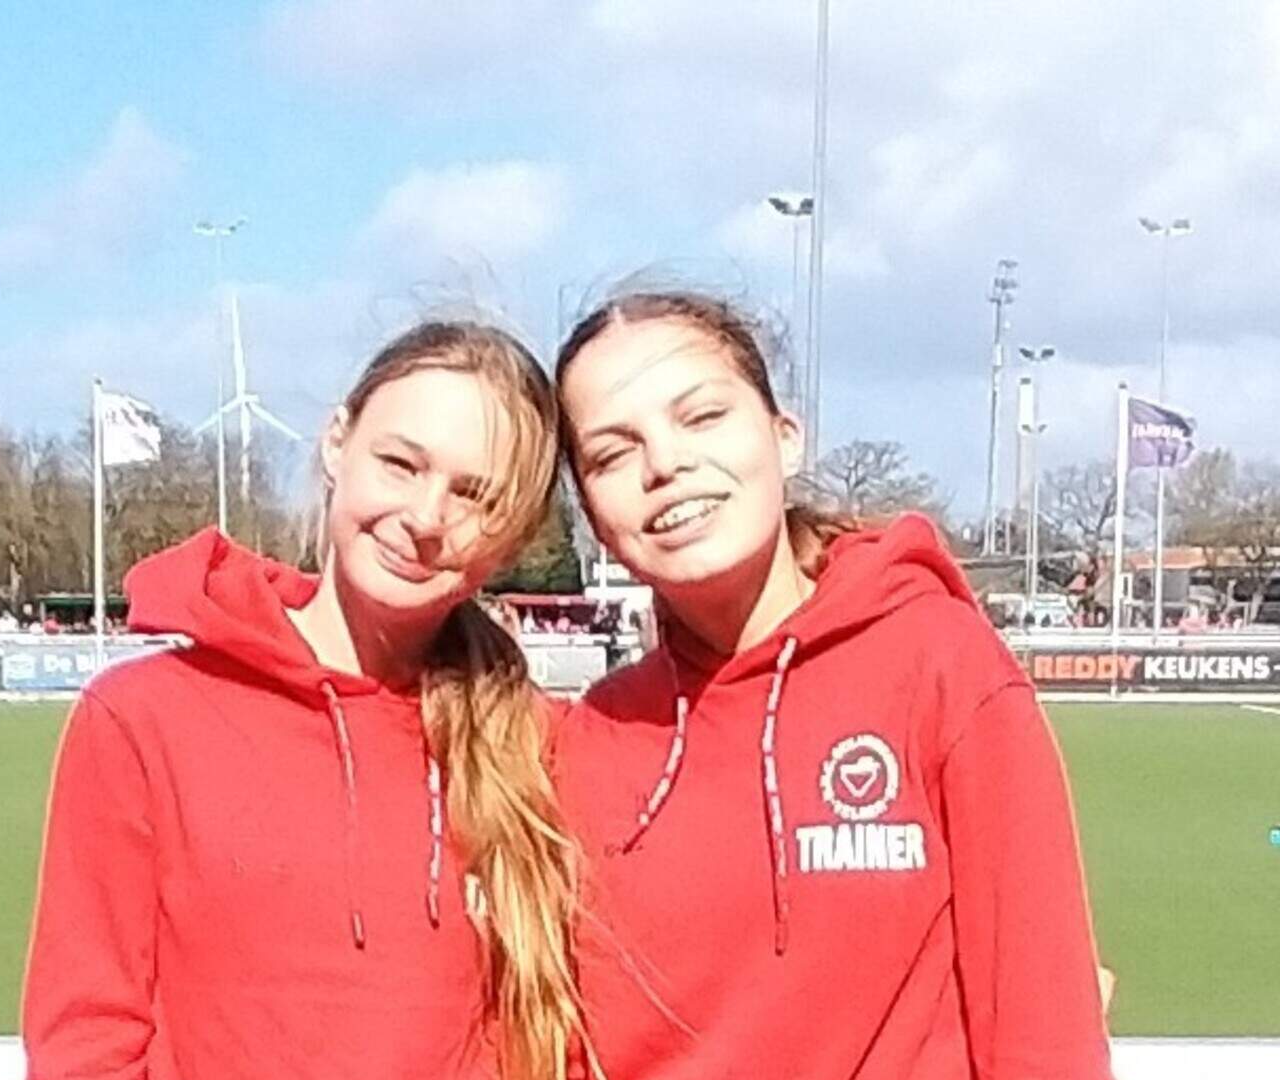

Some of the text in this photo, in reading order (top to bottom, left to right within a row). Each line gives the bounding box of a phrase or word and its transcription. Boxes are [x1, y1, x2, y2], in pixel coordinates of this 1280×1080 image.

[1034, 655, 1142, 679] REDDY
[1144, 656, 1269, 679] KEUKENS
[796, 823, 926, 873] TRAINER
